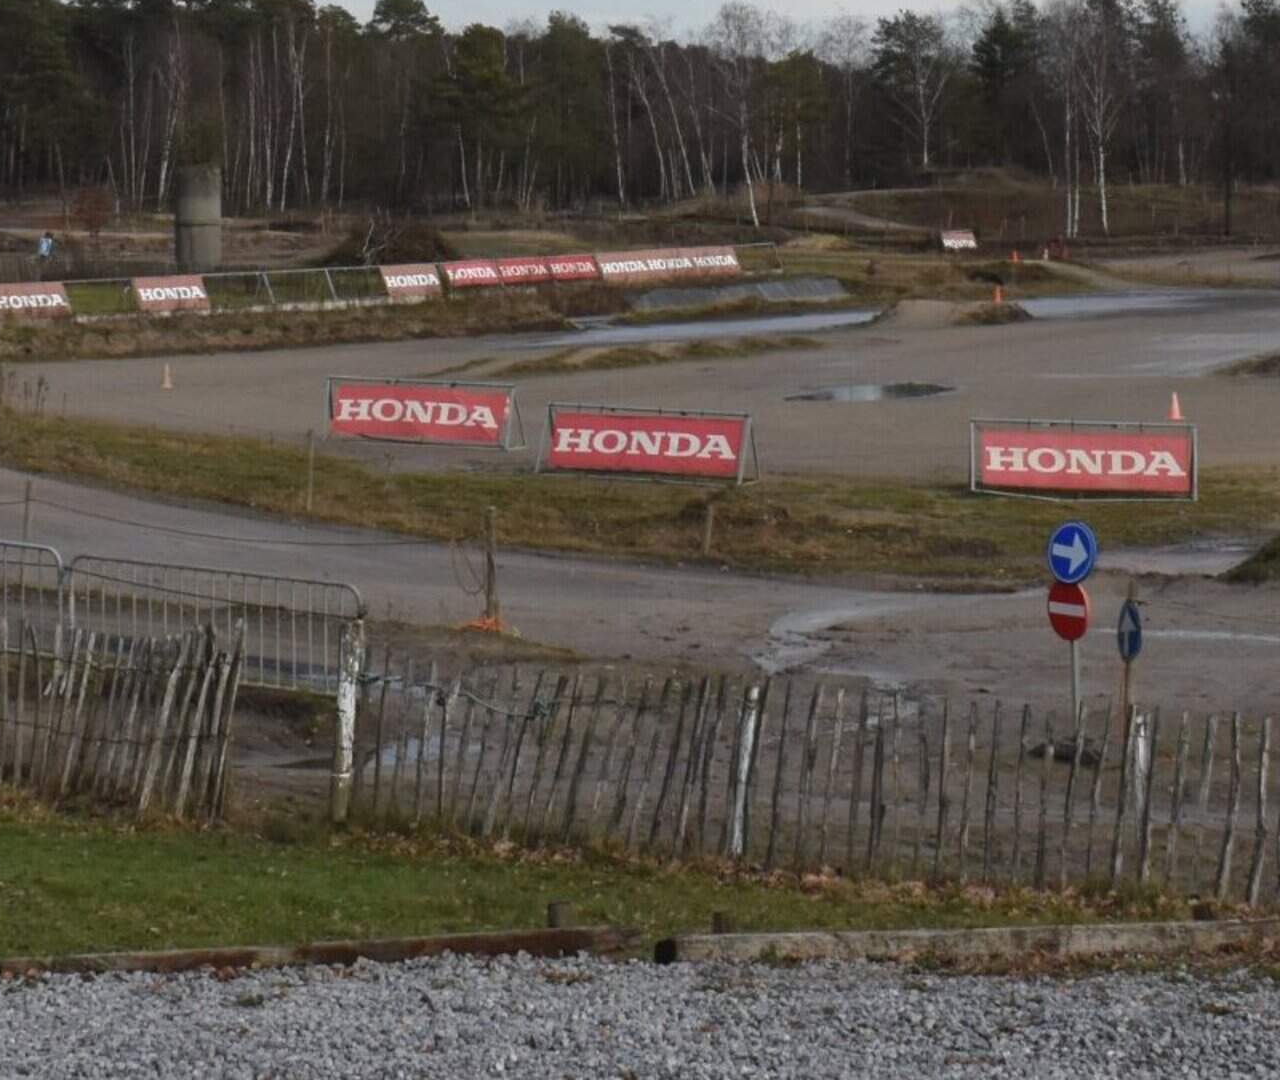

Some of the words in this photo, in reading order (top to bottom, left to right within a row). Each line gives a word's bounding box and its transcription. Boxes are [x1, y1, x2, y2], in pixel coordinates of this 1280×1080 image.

[139, 286, 207, 301] HONDA
[384, 273, 440, 288] HONDA
[335, 397, 499, 429] HONDA
[553, 427, 737, 460] HONDA
[984, 446, 1187, 477] HONDA
